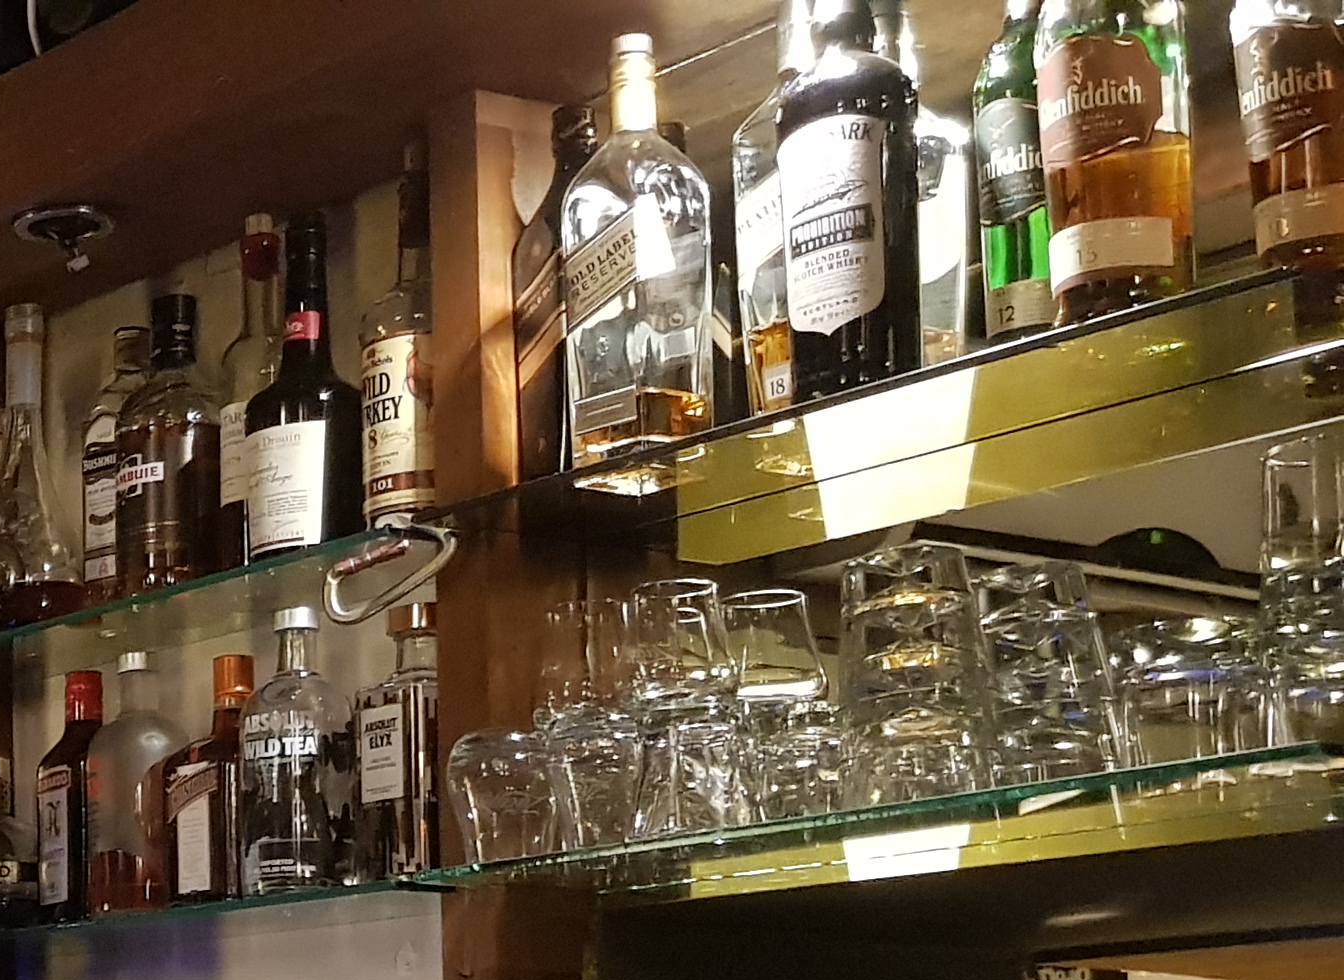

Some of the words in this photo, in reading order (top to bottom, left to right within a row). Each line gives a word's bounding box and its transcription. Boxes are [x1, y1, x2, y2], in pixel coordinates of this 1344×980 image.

[792, 206, 867, 245] PROHIBITION
[804, 248, 851, 269] BLENDED
[570, 243, 637, 299] RESERVE
[770, 377, 786, 398] 18
[367, 428, 378, 450] 8
[372, 478, 394, 493] 101
[243, 737, 281, 761] WILD
[282, 736, 319, 756] TEA
